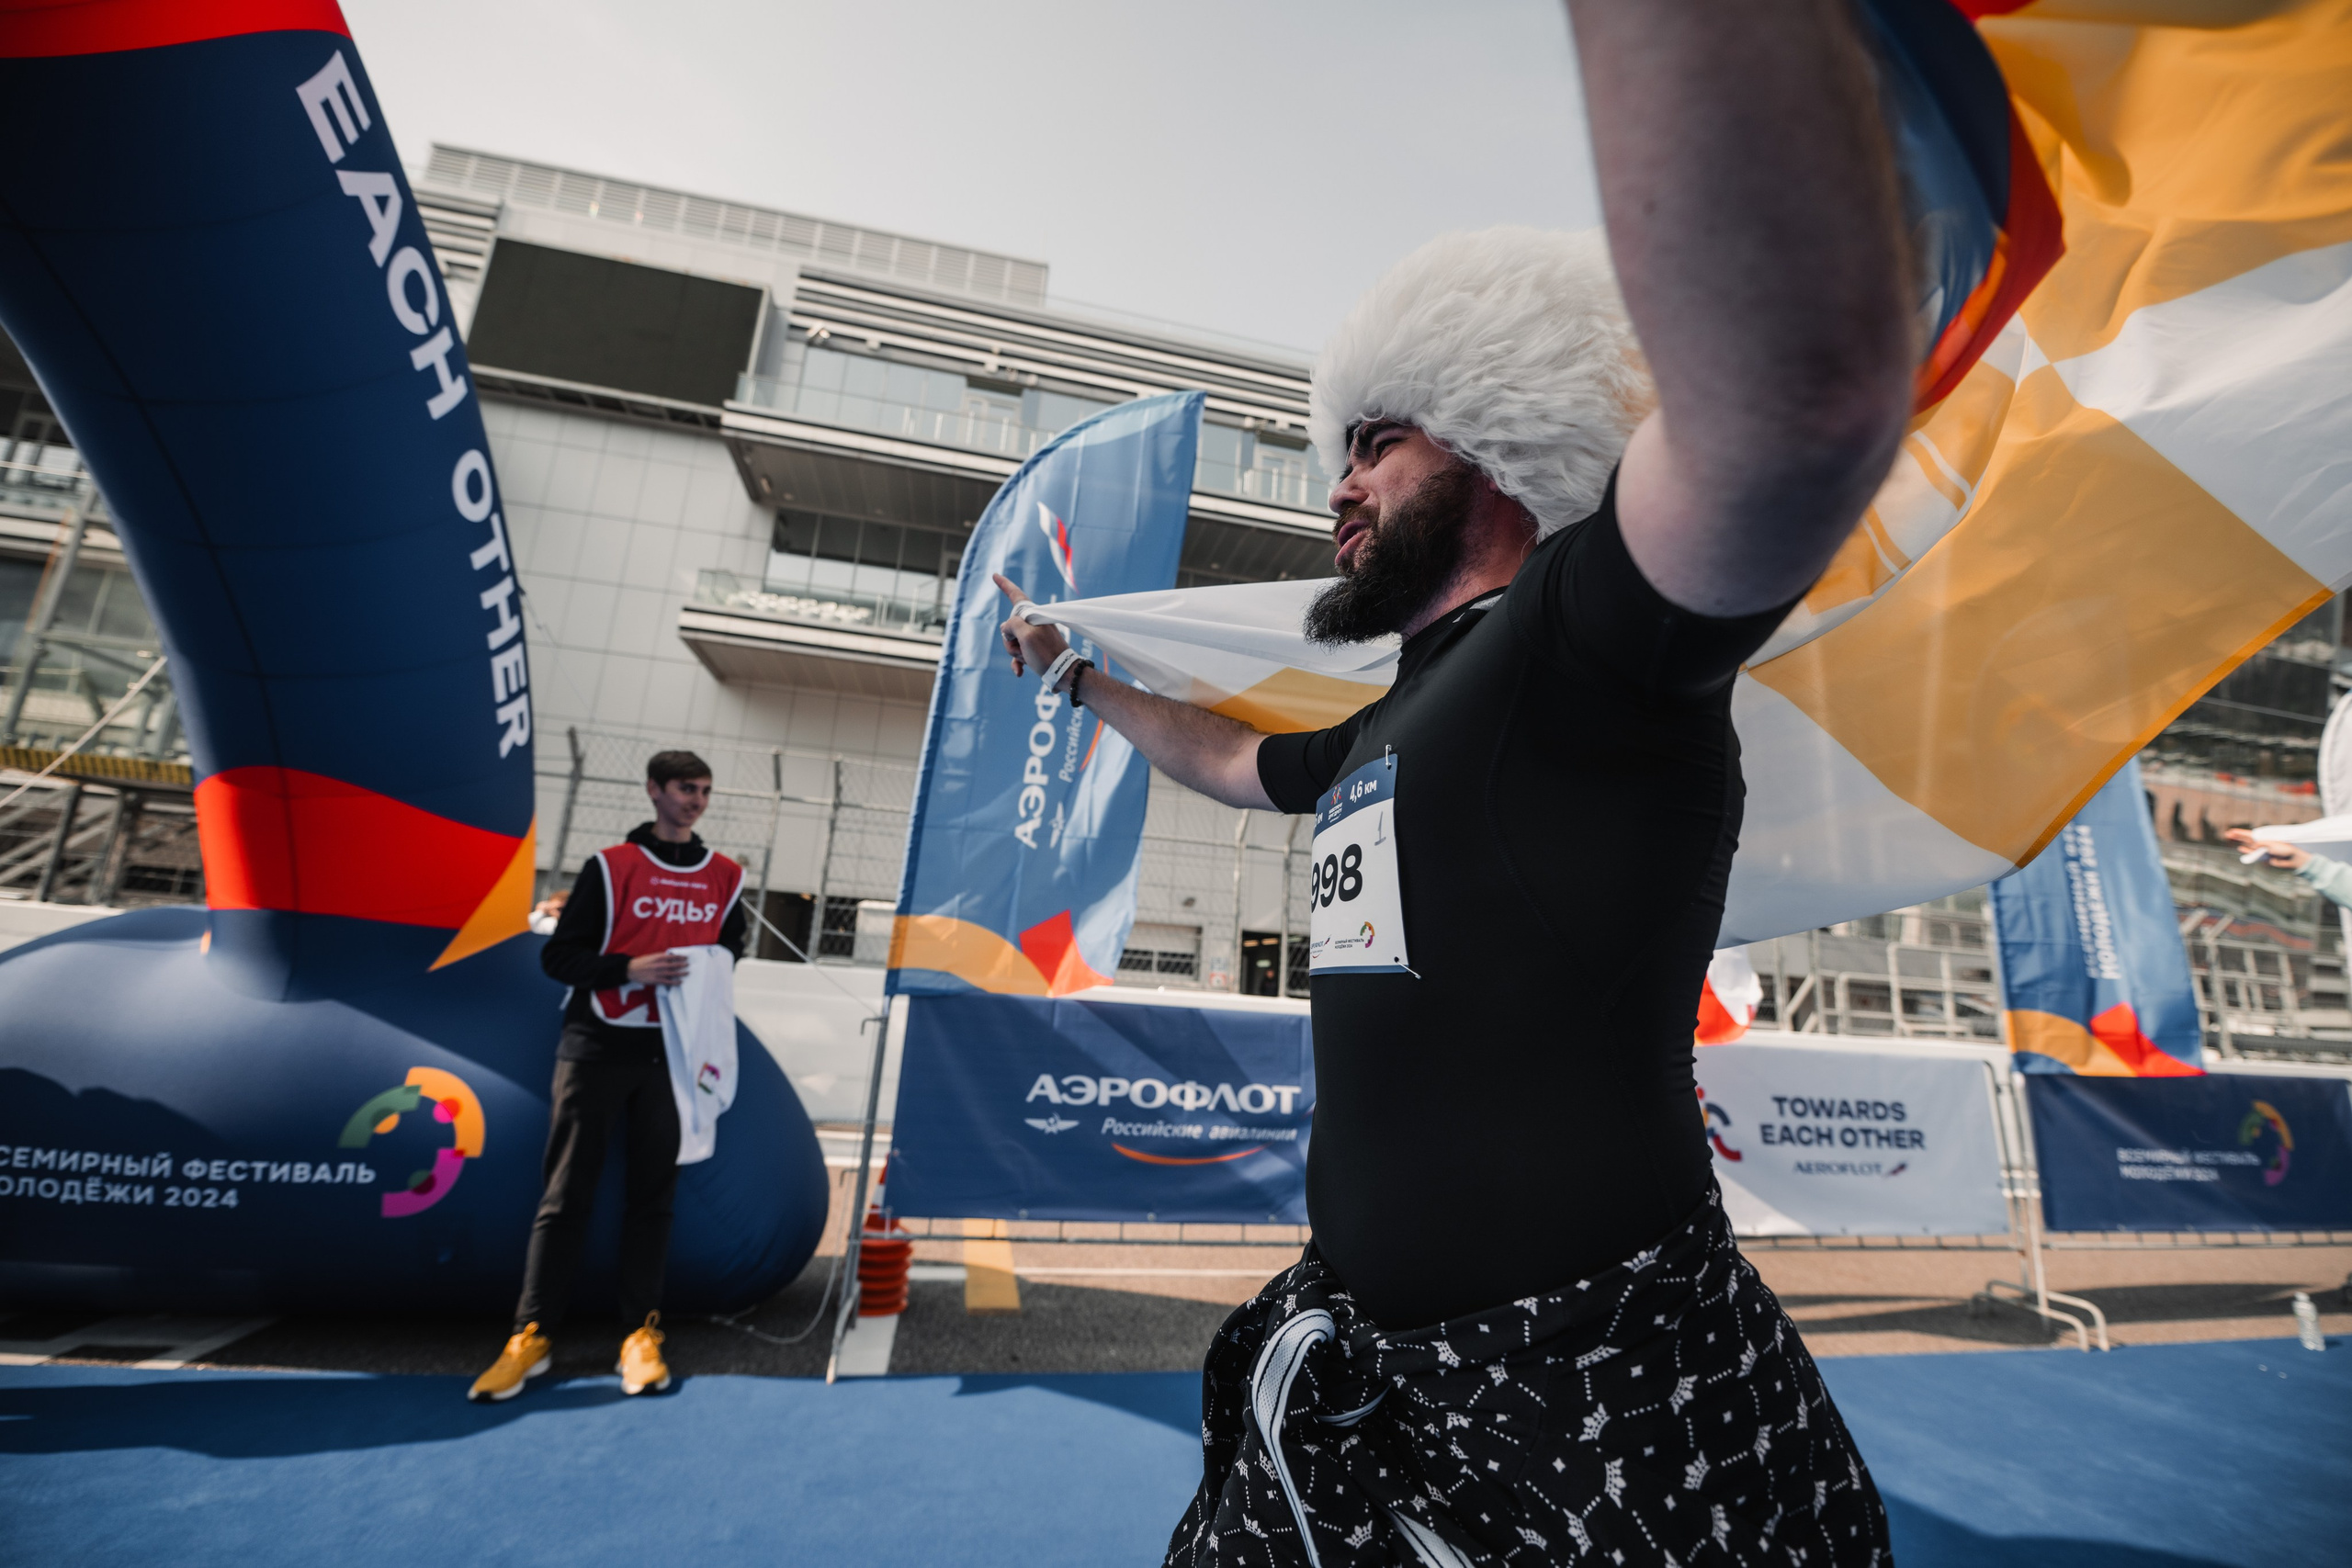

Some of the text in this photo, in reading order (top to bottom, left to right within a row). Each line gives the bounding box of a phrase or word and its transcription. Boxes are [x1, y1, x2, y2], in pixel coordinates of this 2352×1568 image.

[296, 49, 532, 758] EACH OTHER
[1014, 594, 1070, 850] АЭРОФ
[1057, 705, 1084, 783] Российск
[1350, 781, 1363, 803] 4,6
[1311, 843, 1363, 913] 998
[633, 896, 718, 924] СУДЬЯ
[1026, 1074, 1301, 1114] АЭРОФЛОТ
[1772, 1096, 1906, 1122] TOWARDS
[1102, 1117, 1204, 1139] Российские
[1759, 1123, 1926, 1150] EACH OTHER
[183, 1158, 376, 1184] ФЕСТИВАЛЬ
[0, 1175, 239, 1209] ОЛОДЁЖИ 2024
